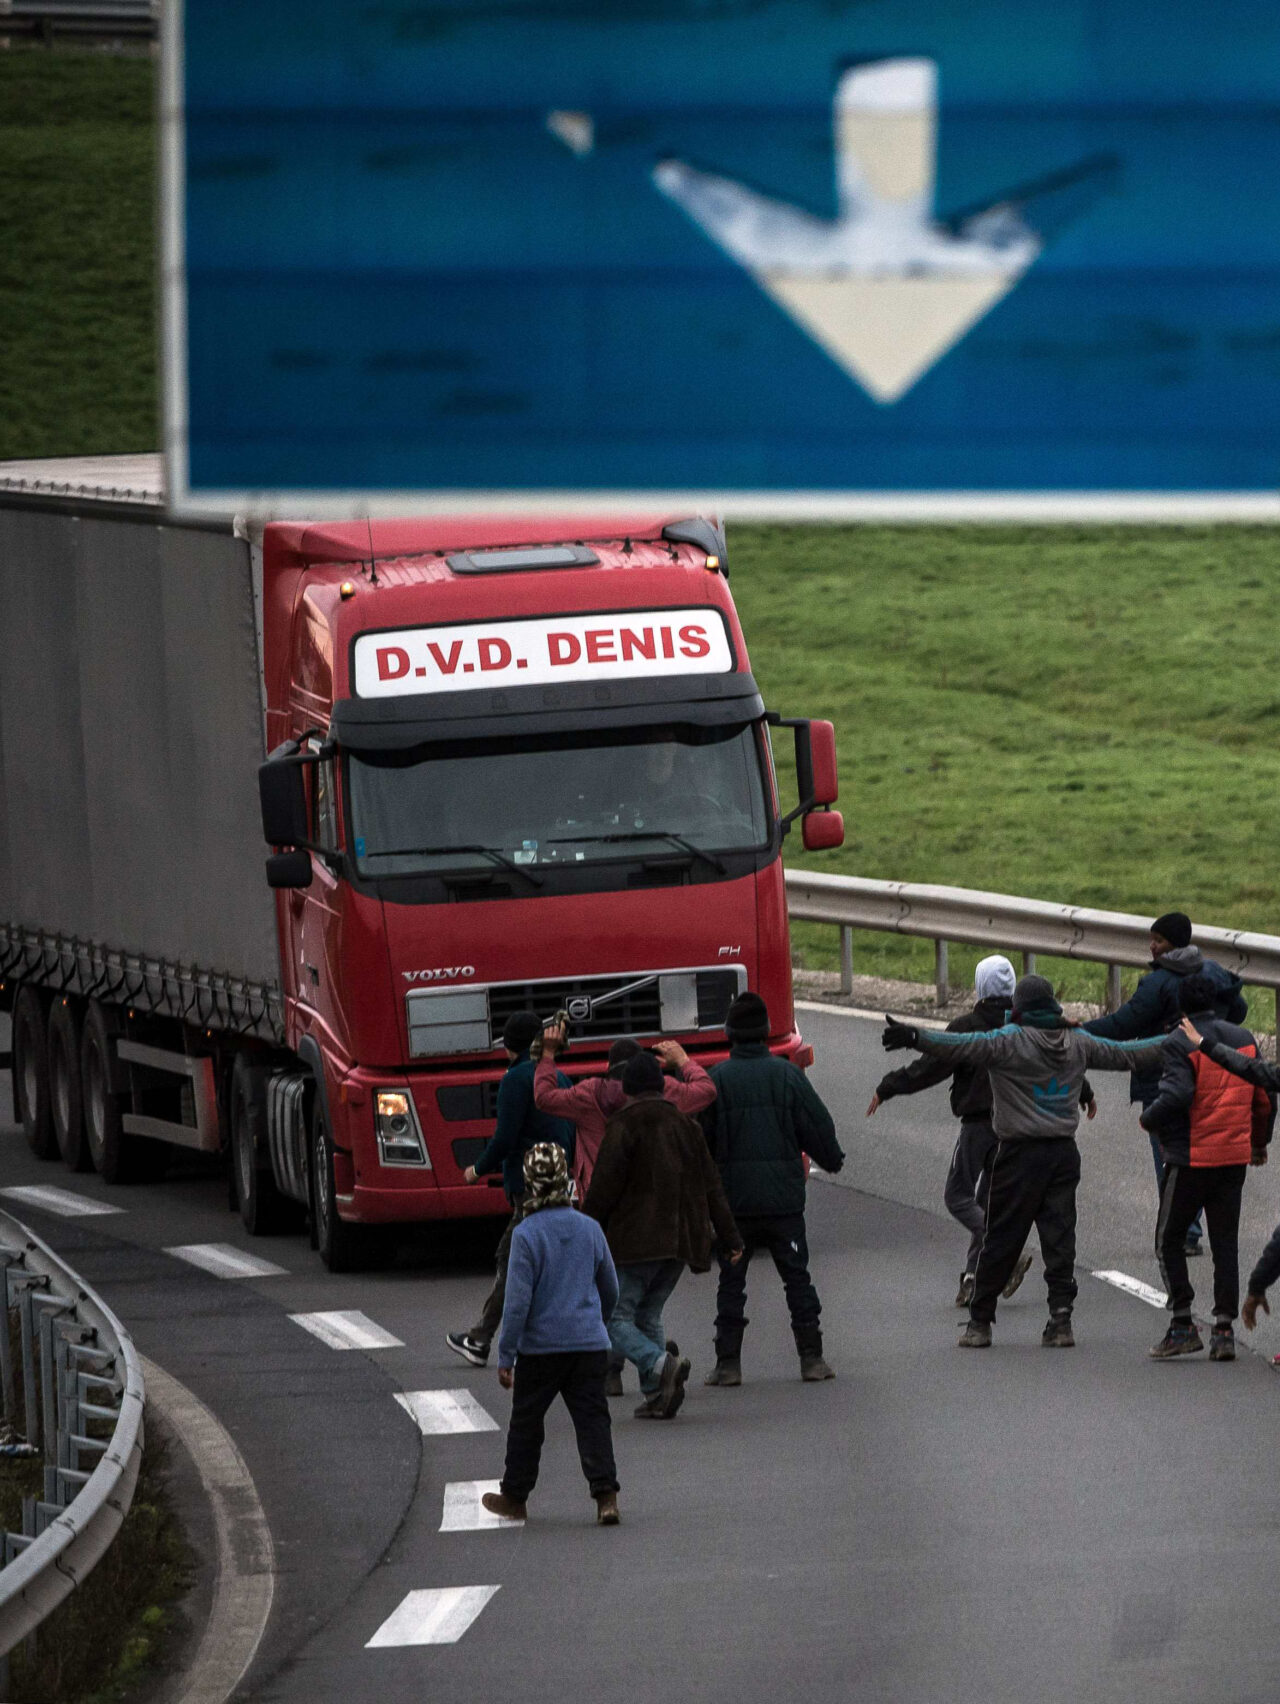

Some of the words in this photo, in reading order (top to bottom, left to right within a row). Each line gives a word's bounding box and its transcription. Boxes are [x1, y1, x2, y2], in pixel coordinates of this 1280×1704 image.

[376, 637, 528, 681] D.V.D.
[547, 625, 711, 667] DENIS
[718, 945, 741, 957] FH
[401, 965, 475, 982] VOLVO
